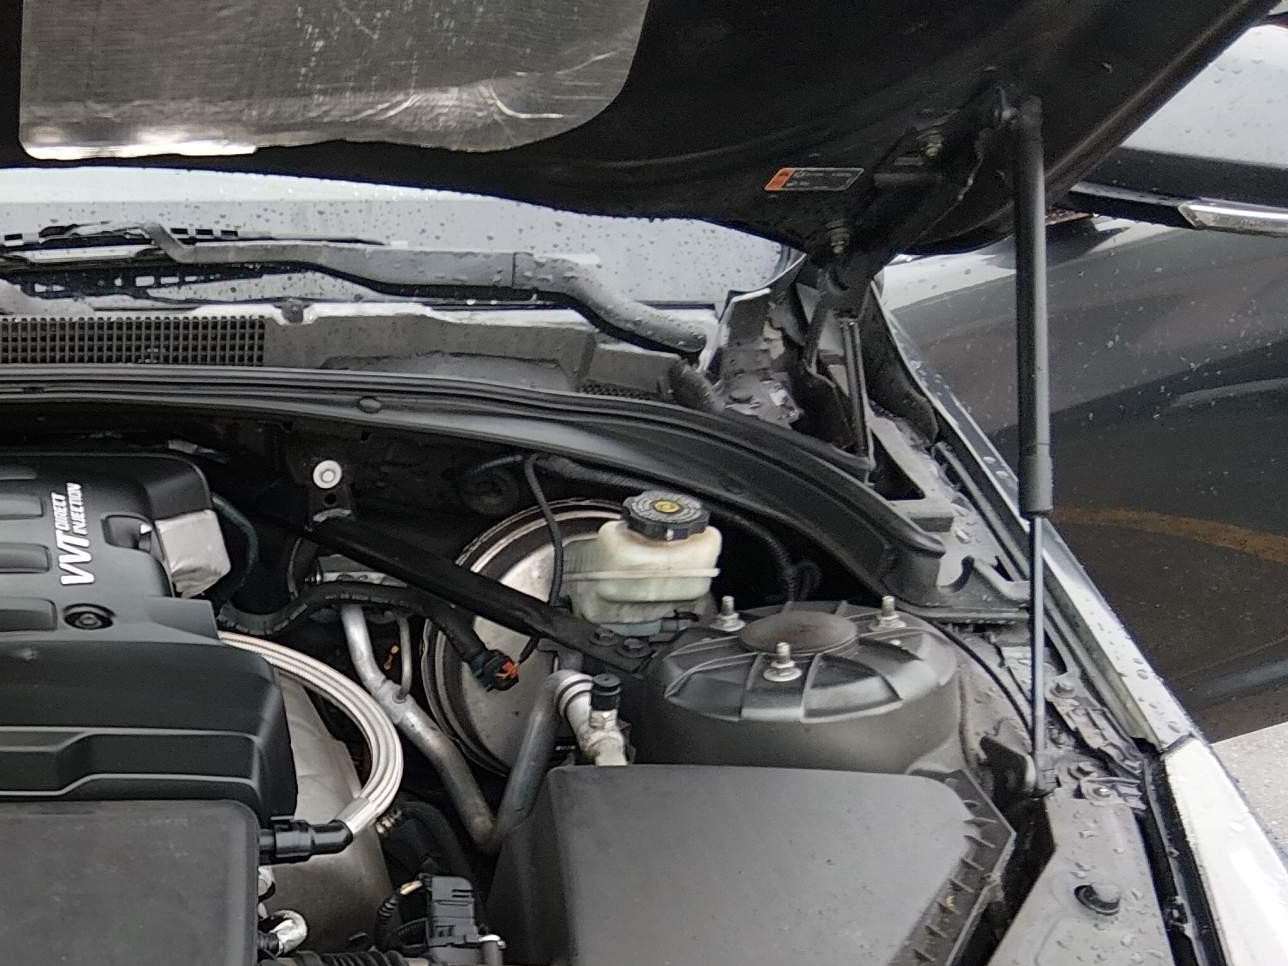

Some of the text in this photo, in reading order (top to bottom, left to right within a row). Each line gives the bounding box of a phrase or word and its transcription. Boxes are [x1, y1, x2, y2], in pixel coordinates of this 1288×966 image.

[51, 492, 70, 532] DIRECT
[66, 482, 88, 535] INJECTION
[55, 530, 95, 585] VVT
